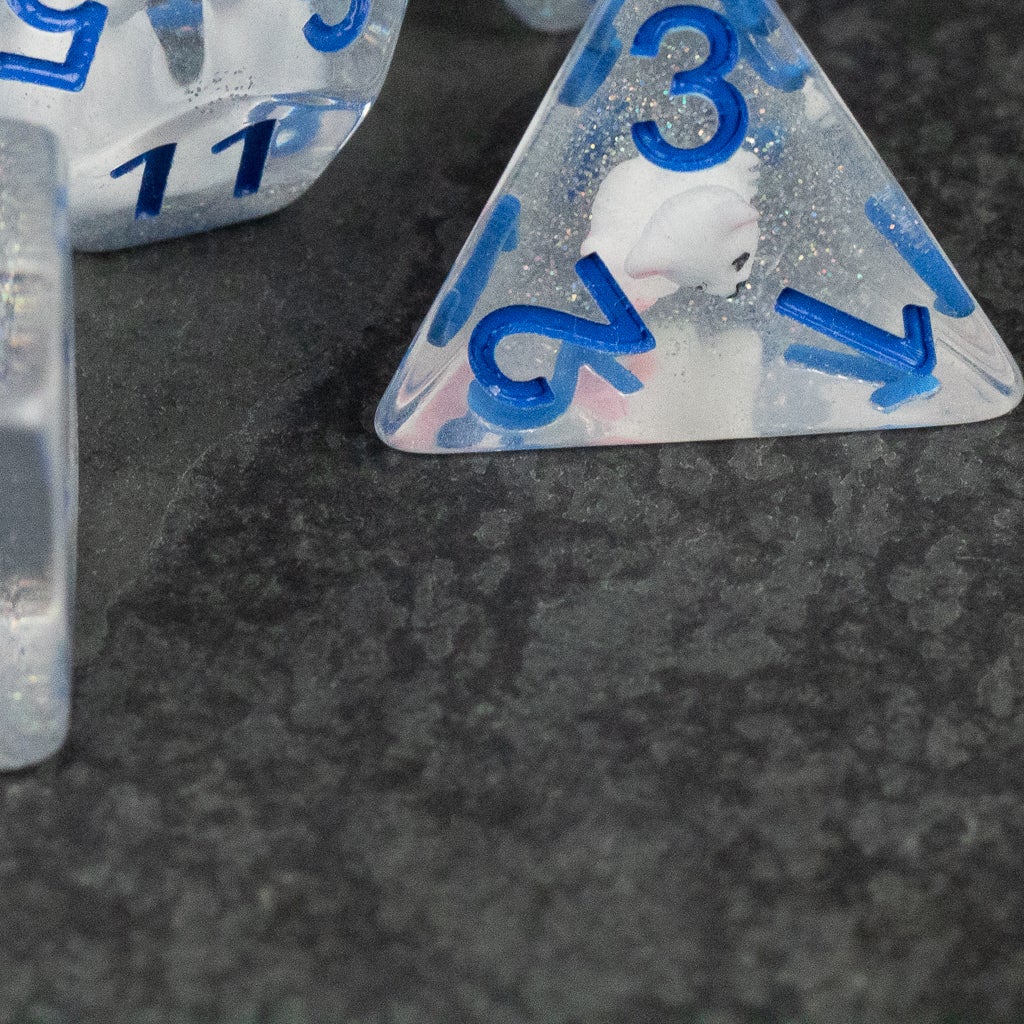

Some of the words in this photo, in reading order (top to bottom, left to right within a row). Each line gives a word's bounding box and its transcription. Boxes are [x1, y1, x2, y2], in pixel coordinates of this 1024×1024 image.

[630, 4, 749, 172] 3
[110, 118, 277, 220] 11
[468, 251, 656, 409] 2
[776, 286, 936, 376] 1
